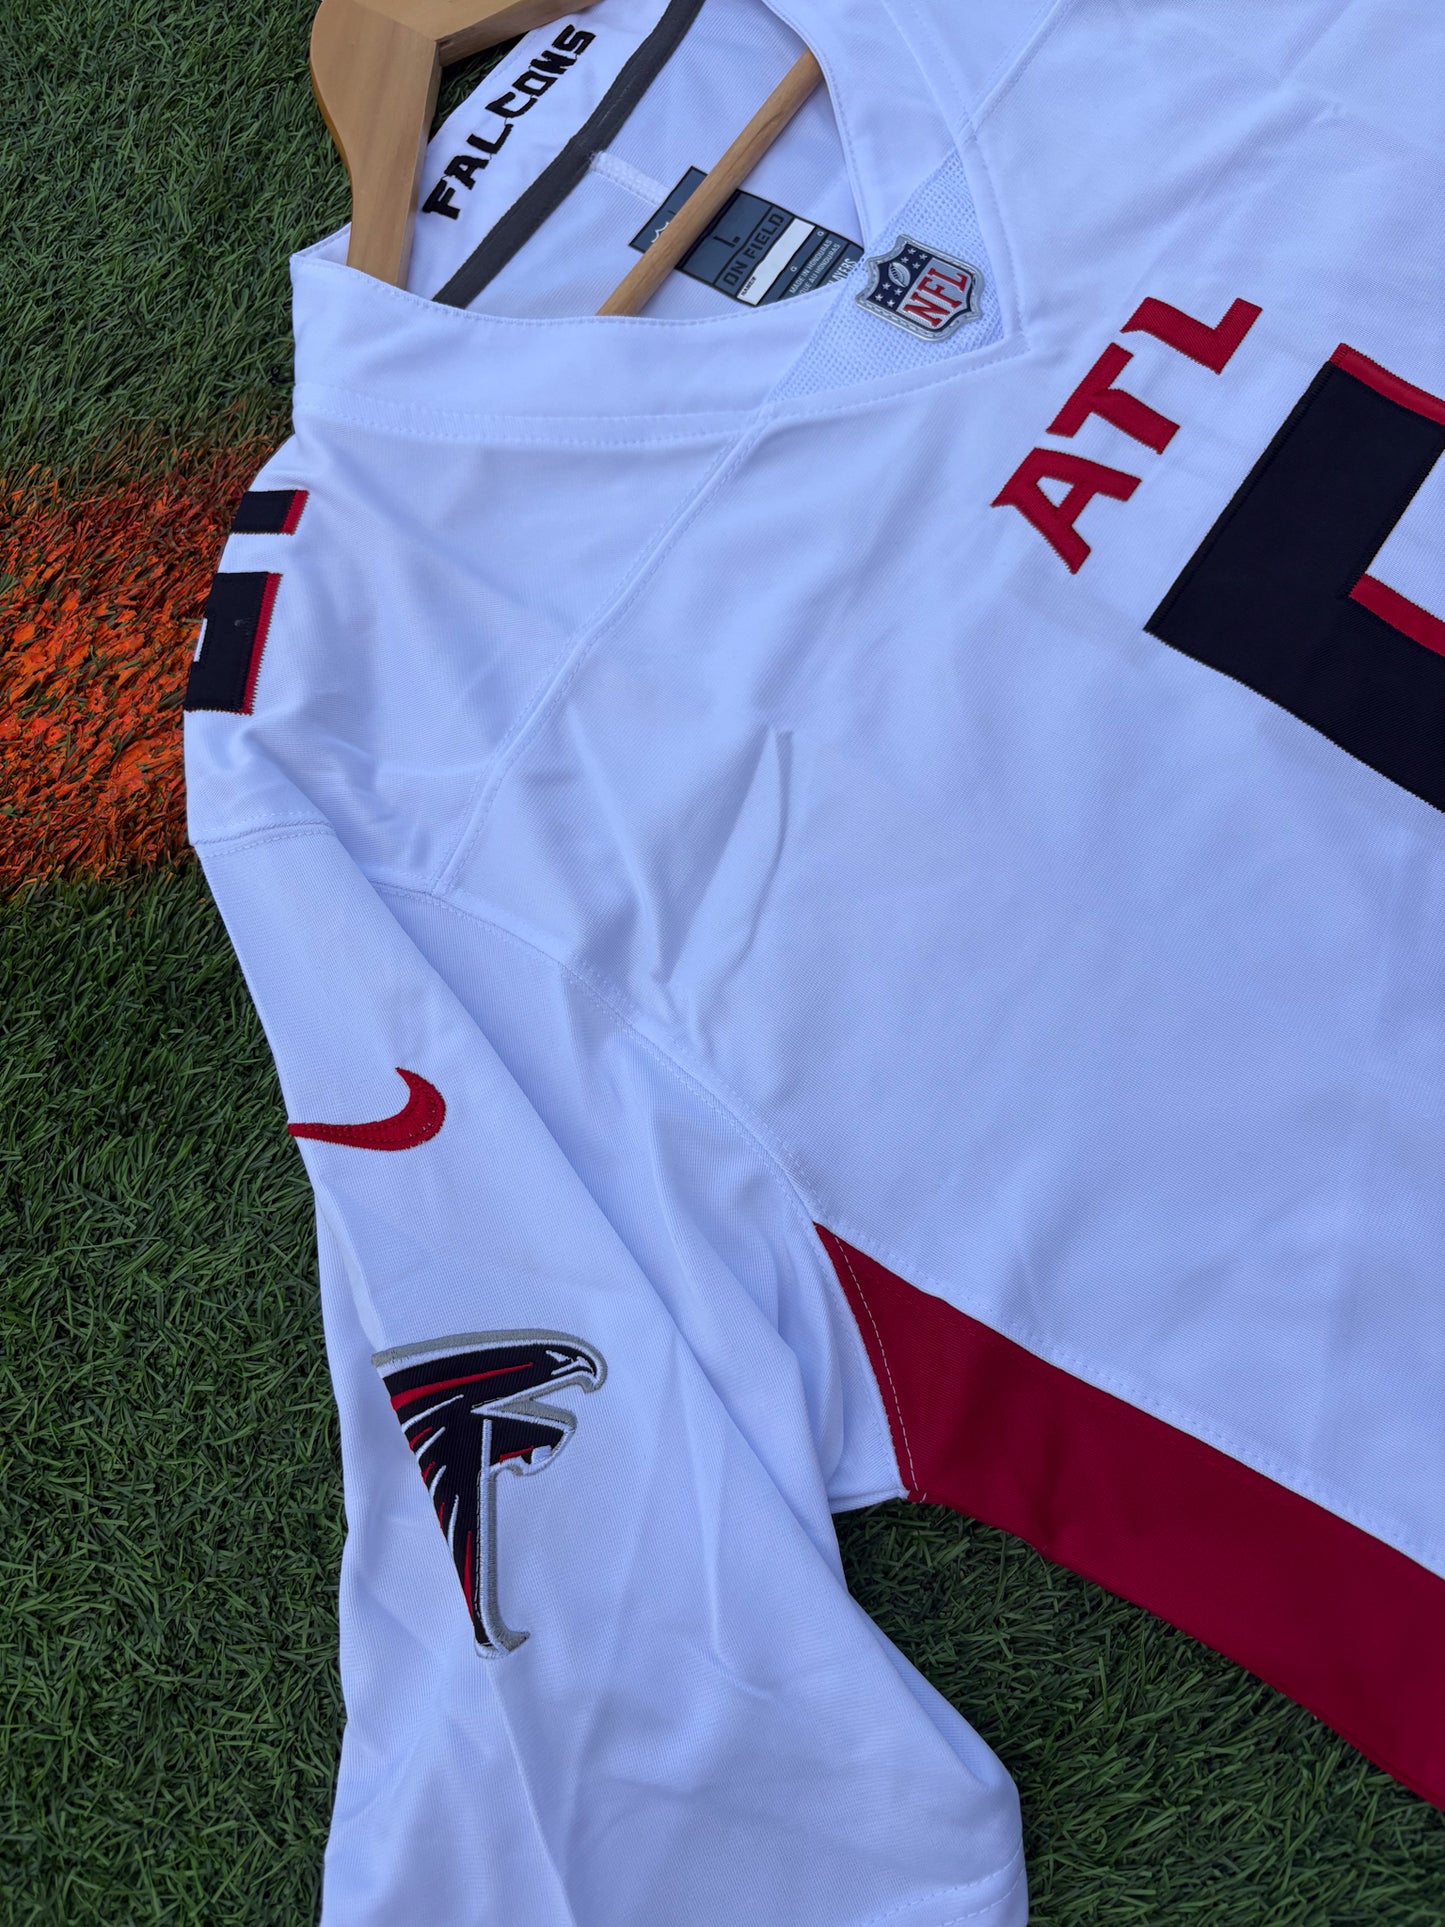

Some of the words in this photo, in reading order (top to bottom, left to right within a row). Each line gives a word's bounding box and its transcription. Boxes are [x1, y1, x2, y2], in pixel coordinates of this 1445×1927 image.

[422, 24, 597, 220] FALCONS
[713, 236, 741, 248] L
[723, 261, 748, 286] ON
[743, 213, 785, 259] FIELD
[789, 275, 804, 294] MADE
[807, 239, 833, 269] HONDURAS
[814, 243, 841, 276] HONDURAS
[828, 258, 857, 284] AYERS
[903, 267, 969, 327] NFL
[990, 296, 1263, 575] ATL
